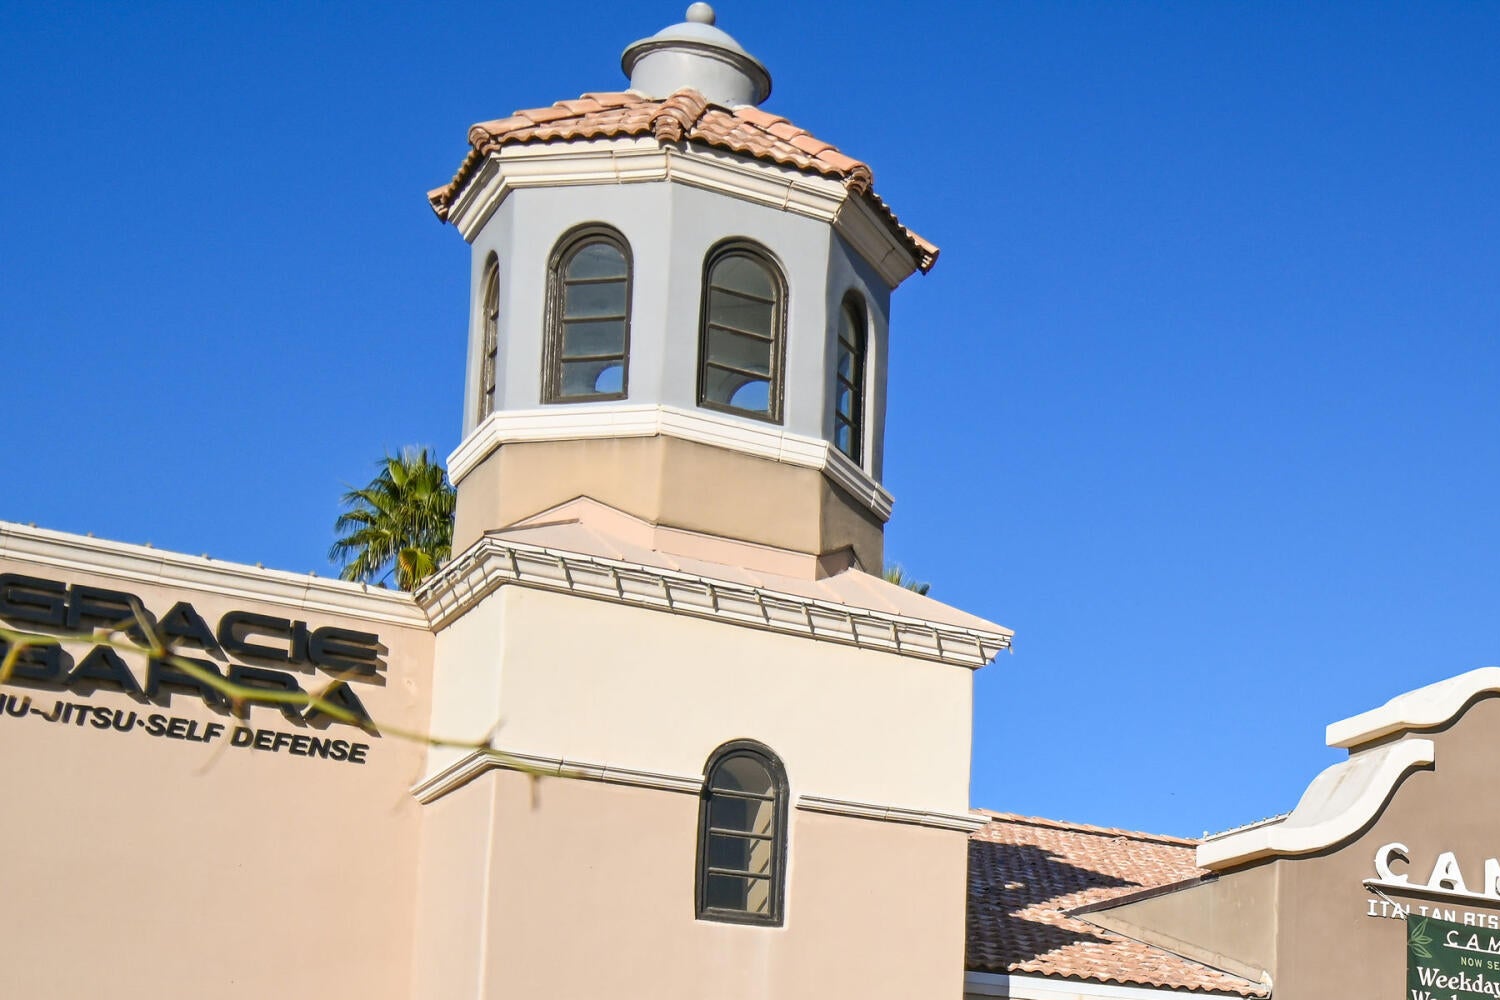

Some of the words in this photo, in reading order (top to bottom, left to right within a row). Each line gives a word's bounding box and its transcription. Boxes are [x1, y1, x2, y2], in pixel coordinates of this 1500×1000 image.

[0, 572, 381, 678] GRACIE
[0, 636, 381, 737] BARRA
[231, 725, 369, 764] DEFENSE
[1460, 956, 1483, 968] NOW
